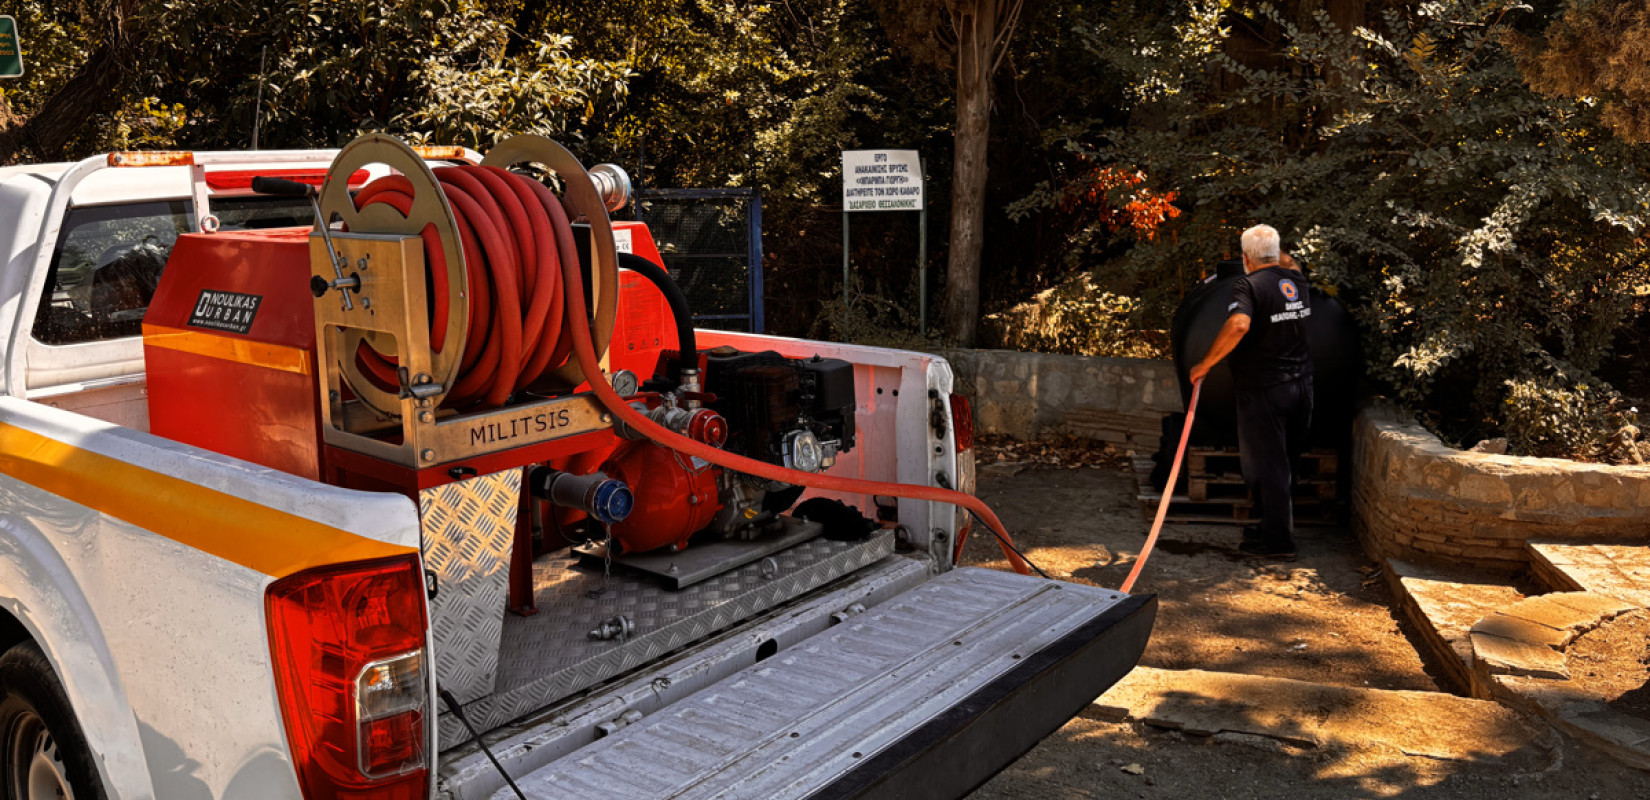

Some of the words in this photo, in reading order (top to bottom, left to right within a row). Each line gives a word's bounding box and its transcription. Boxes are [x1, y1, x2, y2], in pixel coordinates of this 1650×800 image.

[874, 154, 887, 162] ΕΡΓΟ
[890, 164, 908, 172] ΒΡΥΣΗΣ
[874, 188, 884, 196] ΤΟΝ
[886, 187, 898, 196] ΧΩΡΟ
[900, 186, 920, 196] ΚΑΘΑΡΟ
[210, 292, 258, 308] NOULIKAS
[206, 306, 252, 323] URBAN
[471, 409, 570, 446] MILITSIS
